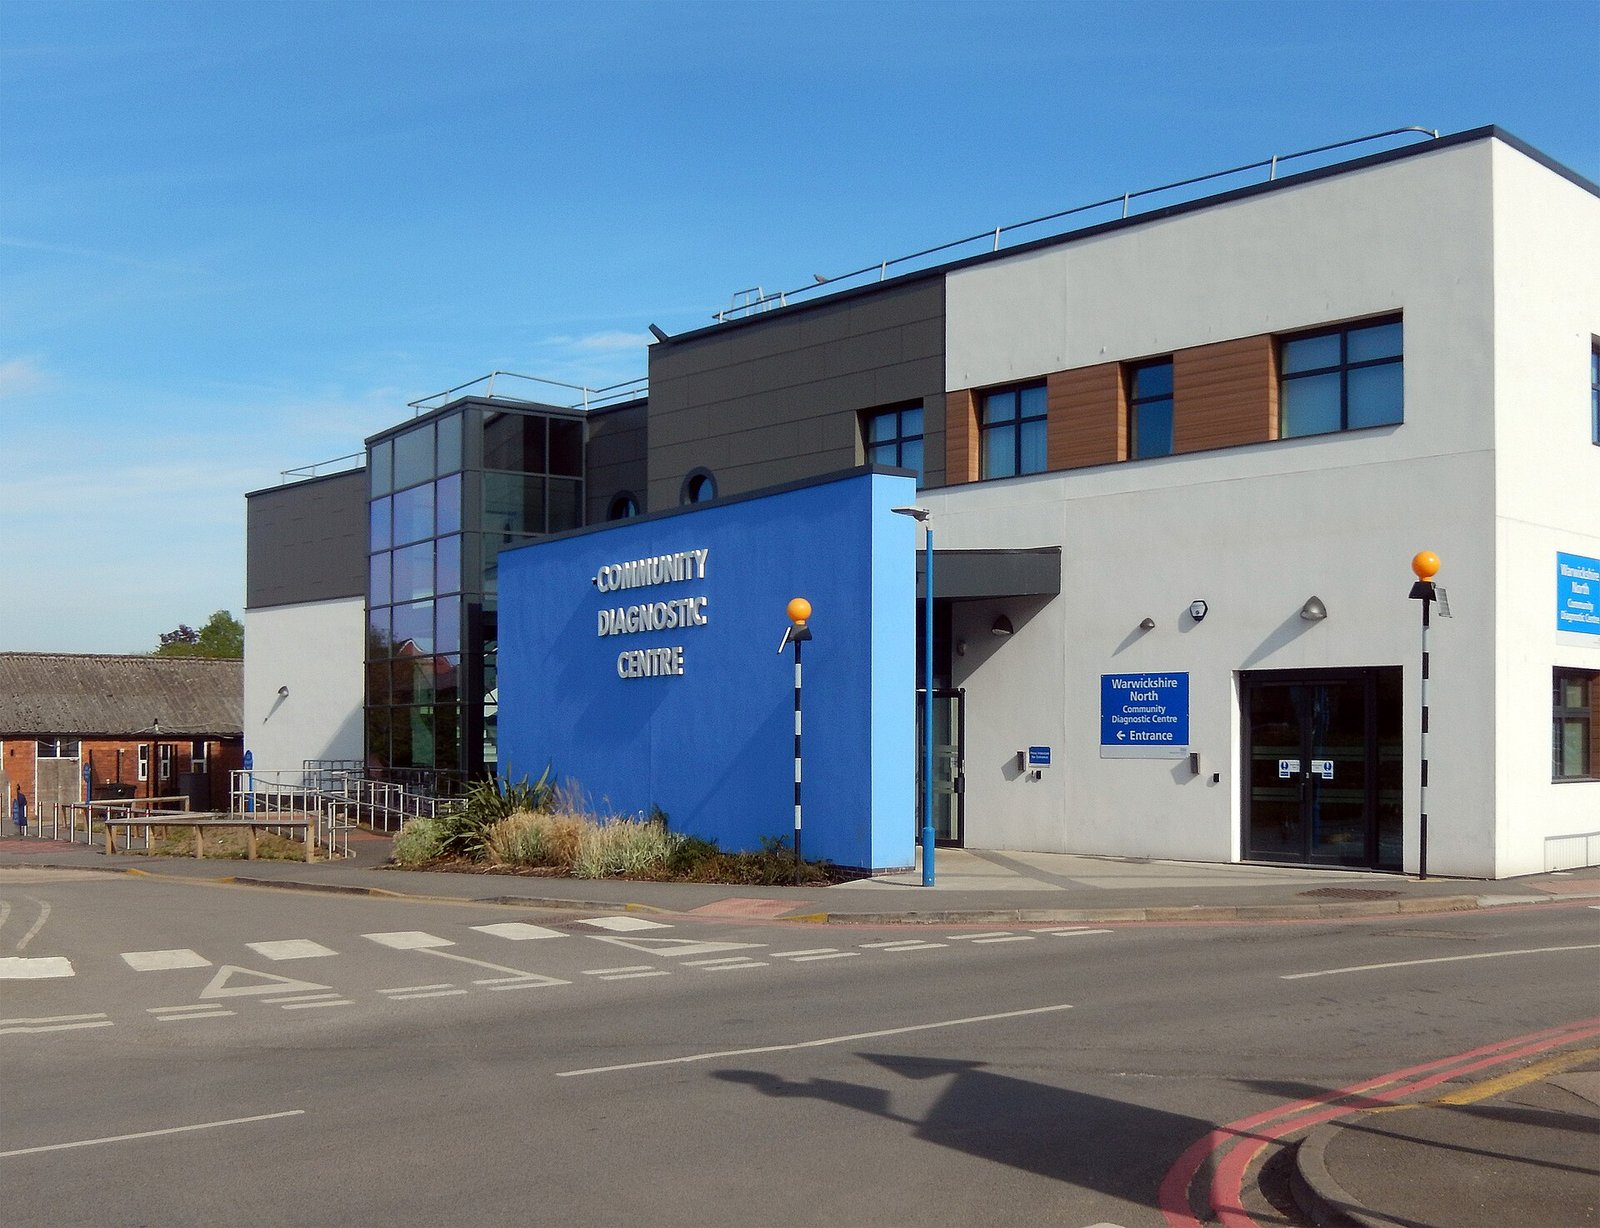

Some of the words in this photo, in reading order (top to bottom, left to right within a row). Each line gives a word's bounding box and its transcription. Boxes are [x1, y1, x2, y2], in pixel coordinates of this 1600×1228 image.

[597, 548, 708, 592] COMMUNITY
[597, 596, 708, 637] DIAGNOSTIC
[617, 646, 684, 679] CENTRE
[1112, 677, 1178, 689] Warwickshire
[1130, 691, 1158, 701] North
[1122, 705, 1166, 714] Community
[1112, 715, 1150, 725] Diagnostic
[1152, 715, 1178, 723] Centre
[1130, 730, 1173, 740] Entrance
